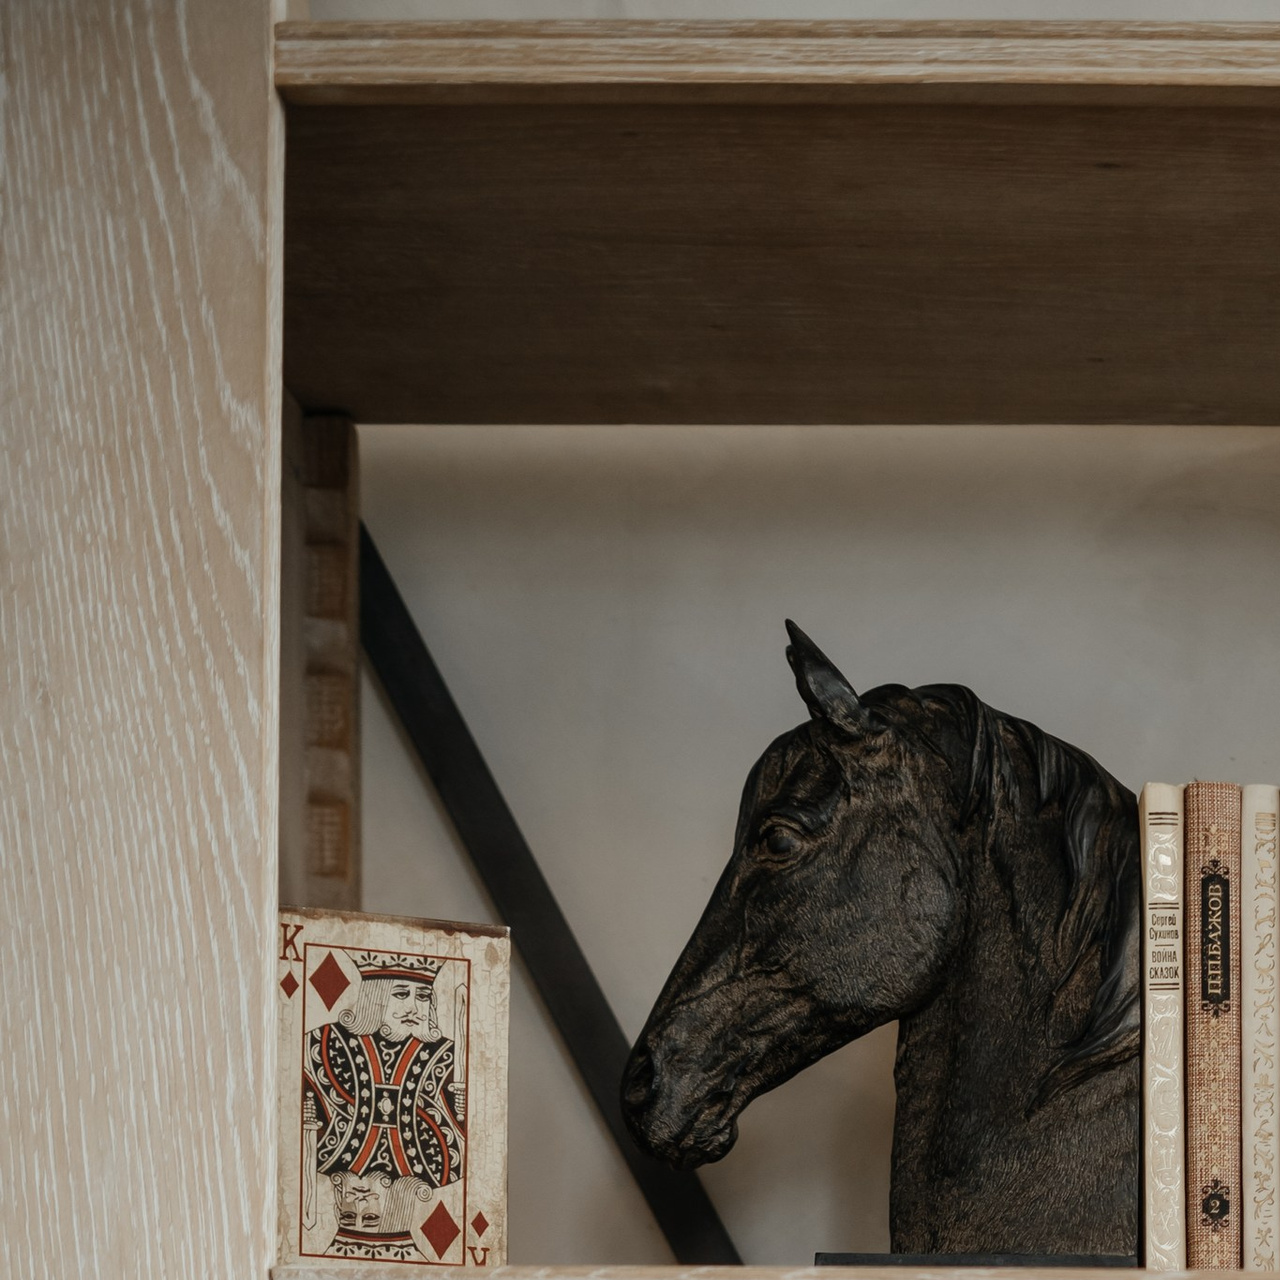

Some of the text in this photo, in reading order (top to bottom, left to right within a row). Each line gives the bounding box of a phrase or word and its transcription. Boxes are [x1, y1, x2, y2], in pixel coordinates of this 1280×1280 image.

[1151, 913, 1176, 926] Сергей
[1149, 929, 1179, 941] Сухинов
[280, 924, 304, 962] K
[1152, 948, 1177, 962] ВОЙНА
[1149, 966, 1179, 980] СКАЗОК
